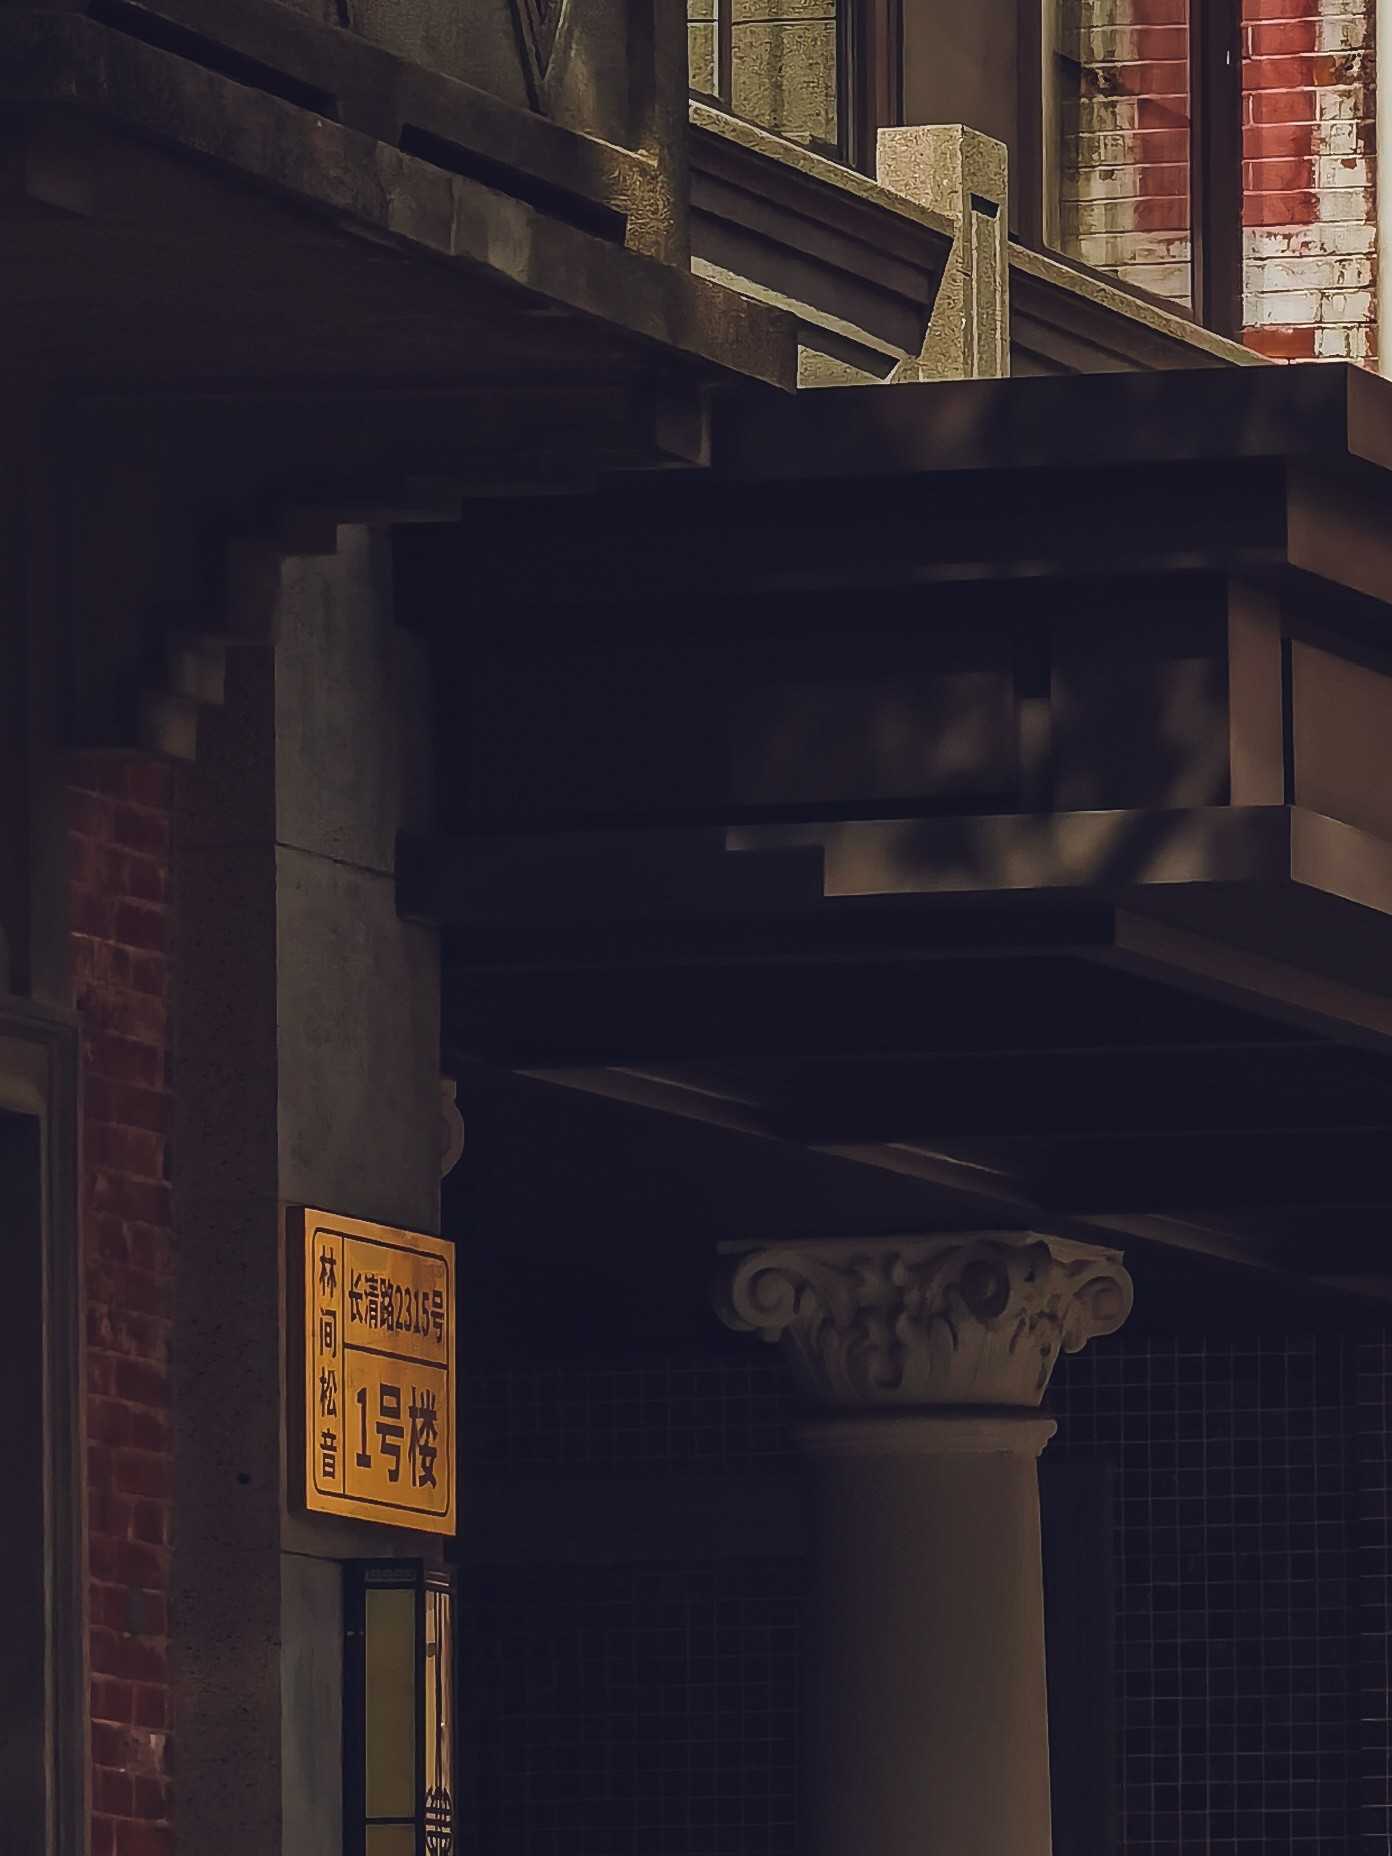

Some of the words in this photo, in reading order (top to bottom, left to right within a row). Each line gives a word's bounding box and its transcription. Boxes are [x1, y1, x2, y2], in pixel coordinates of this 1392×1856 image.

[348, 1267, 445, 1344] 长清路2315号
[319, 1245, 337, 1480] 林间松音
[355, 1382, 439, 1489] 1号楼
